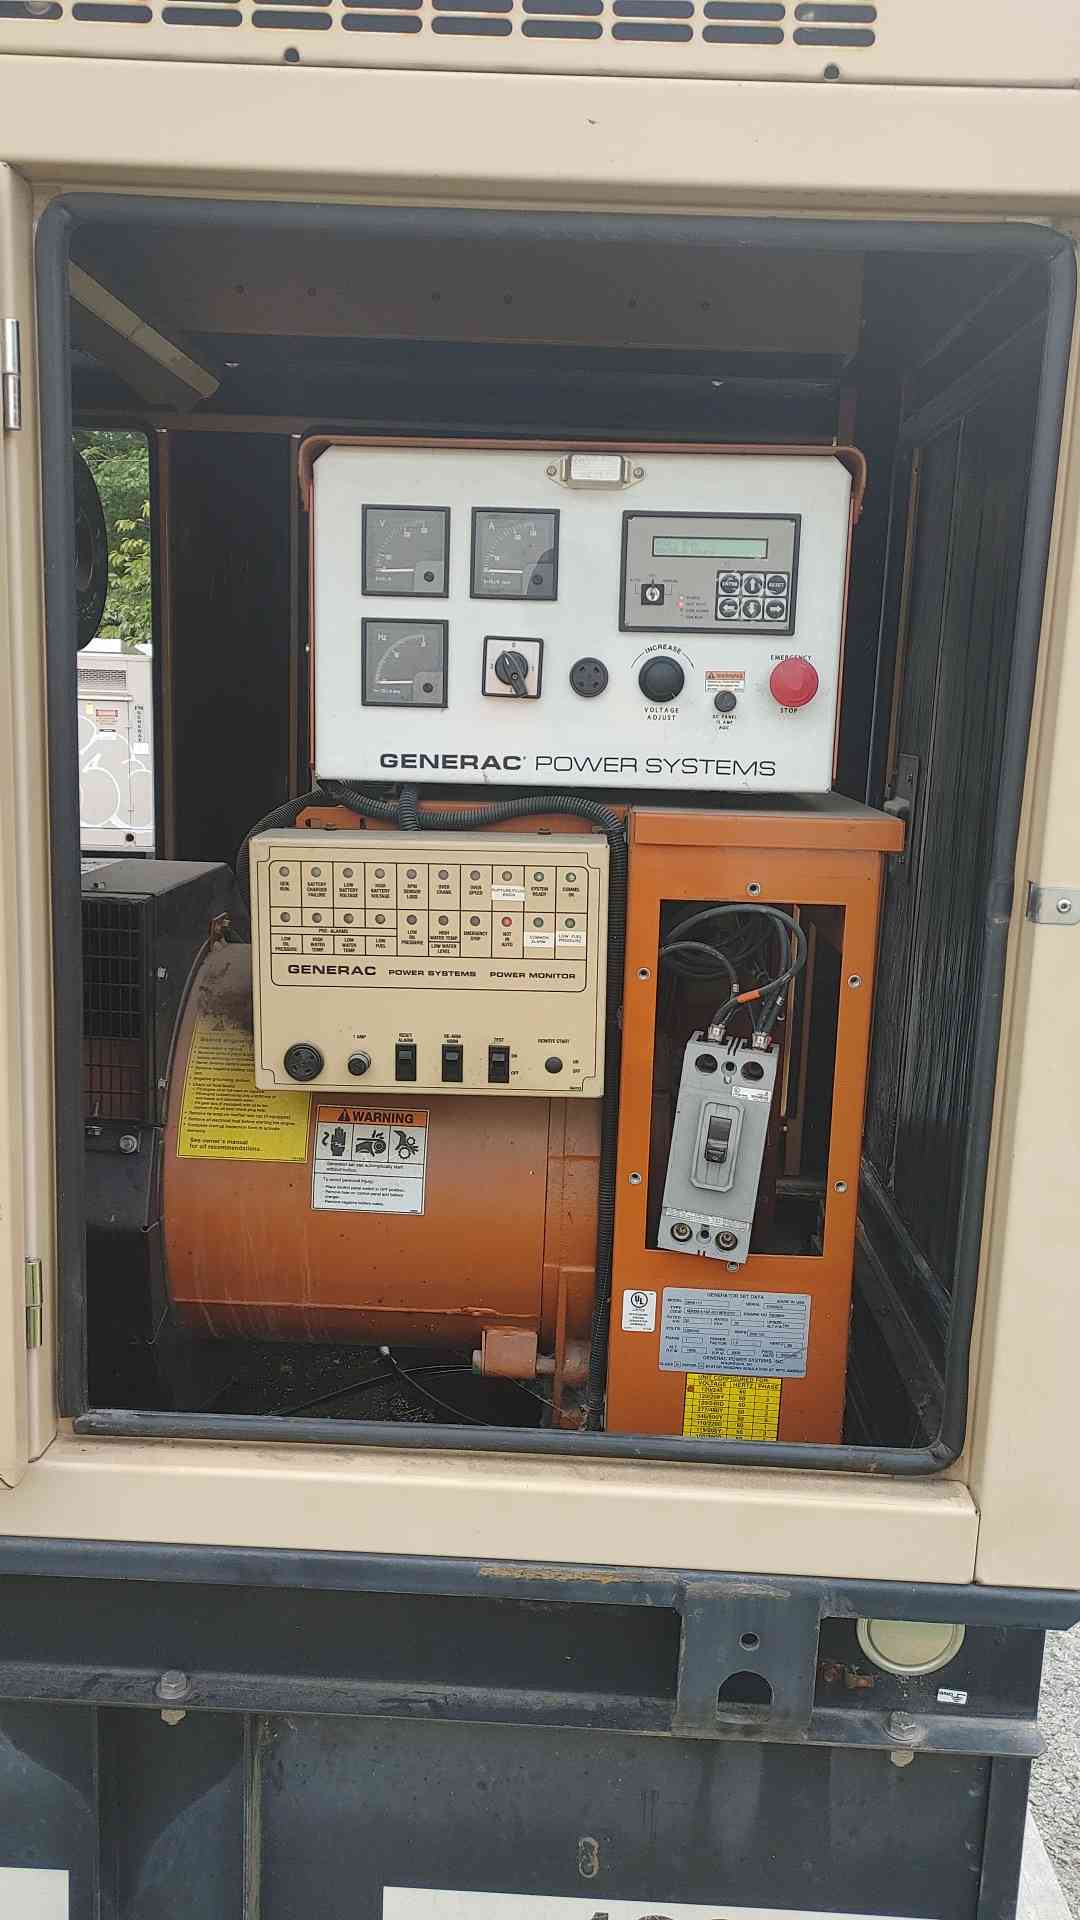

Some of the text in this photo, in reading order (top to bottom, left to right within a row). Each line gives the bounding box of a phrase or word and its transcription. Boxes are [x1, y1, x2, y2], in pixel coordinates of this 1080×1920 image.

[644, 644, 682, 655] INCREASE
[644, 706, 680, 714] VOLTAGE
[380, 752, 778, 776] GENERAC POWER SYSTEMS
[288, 964, 377, 976] GENERAC
[352, 1111, 414, 1124] WARNING
